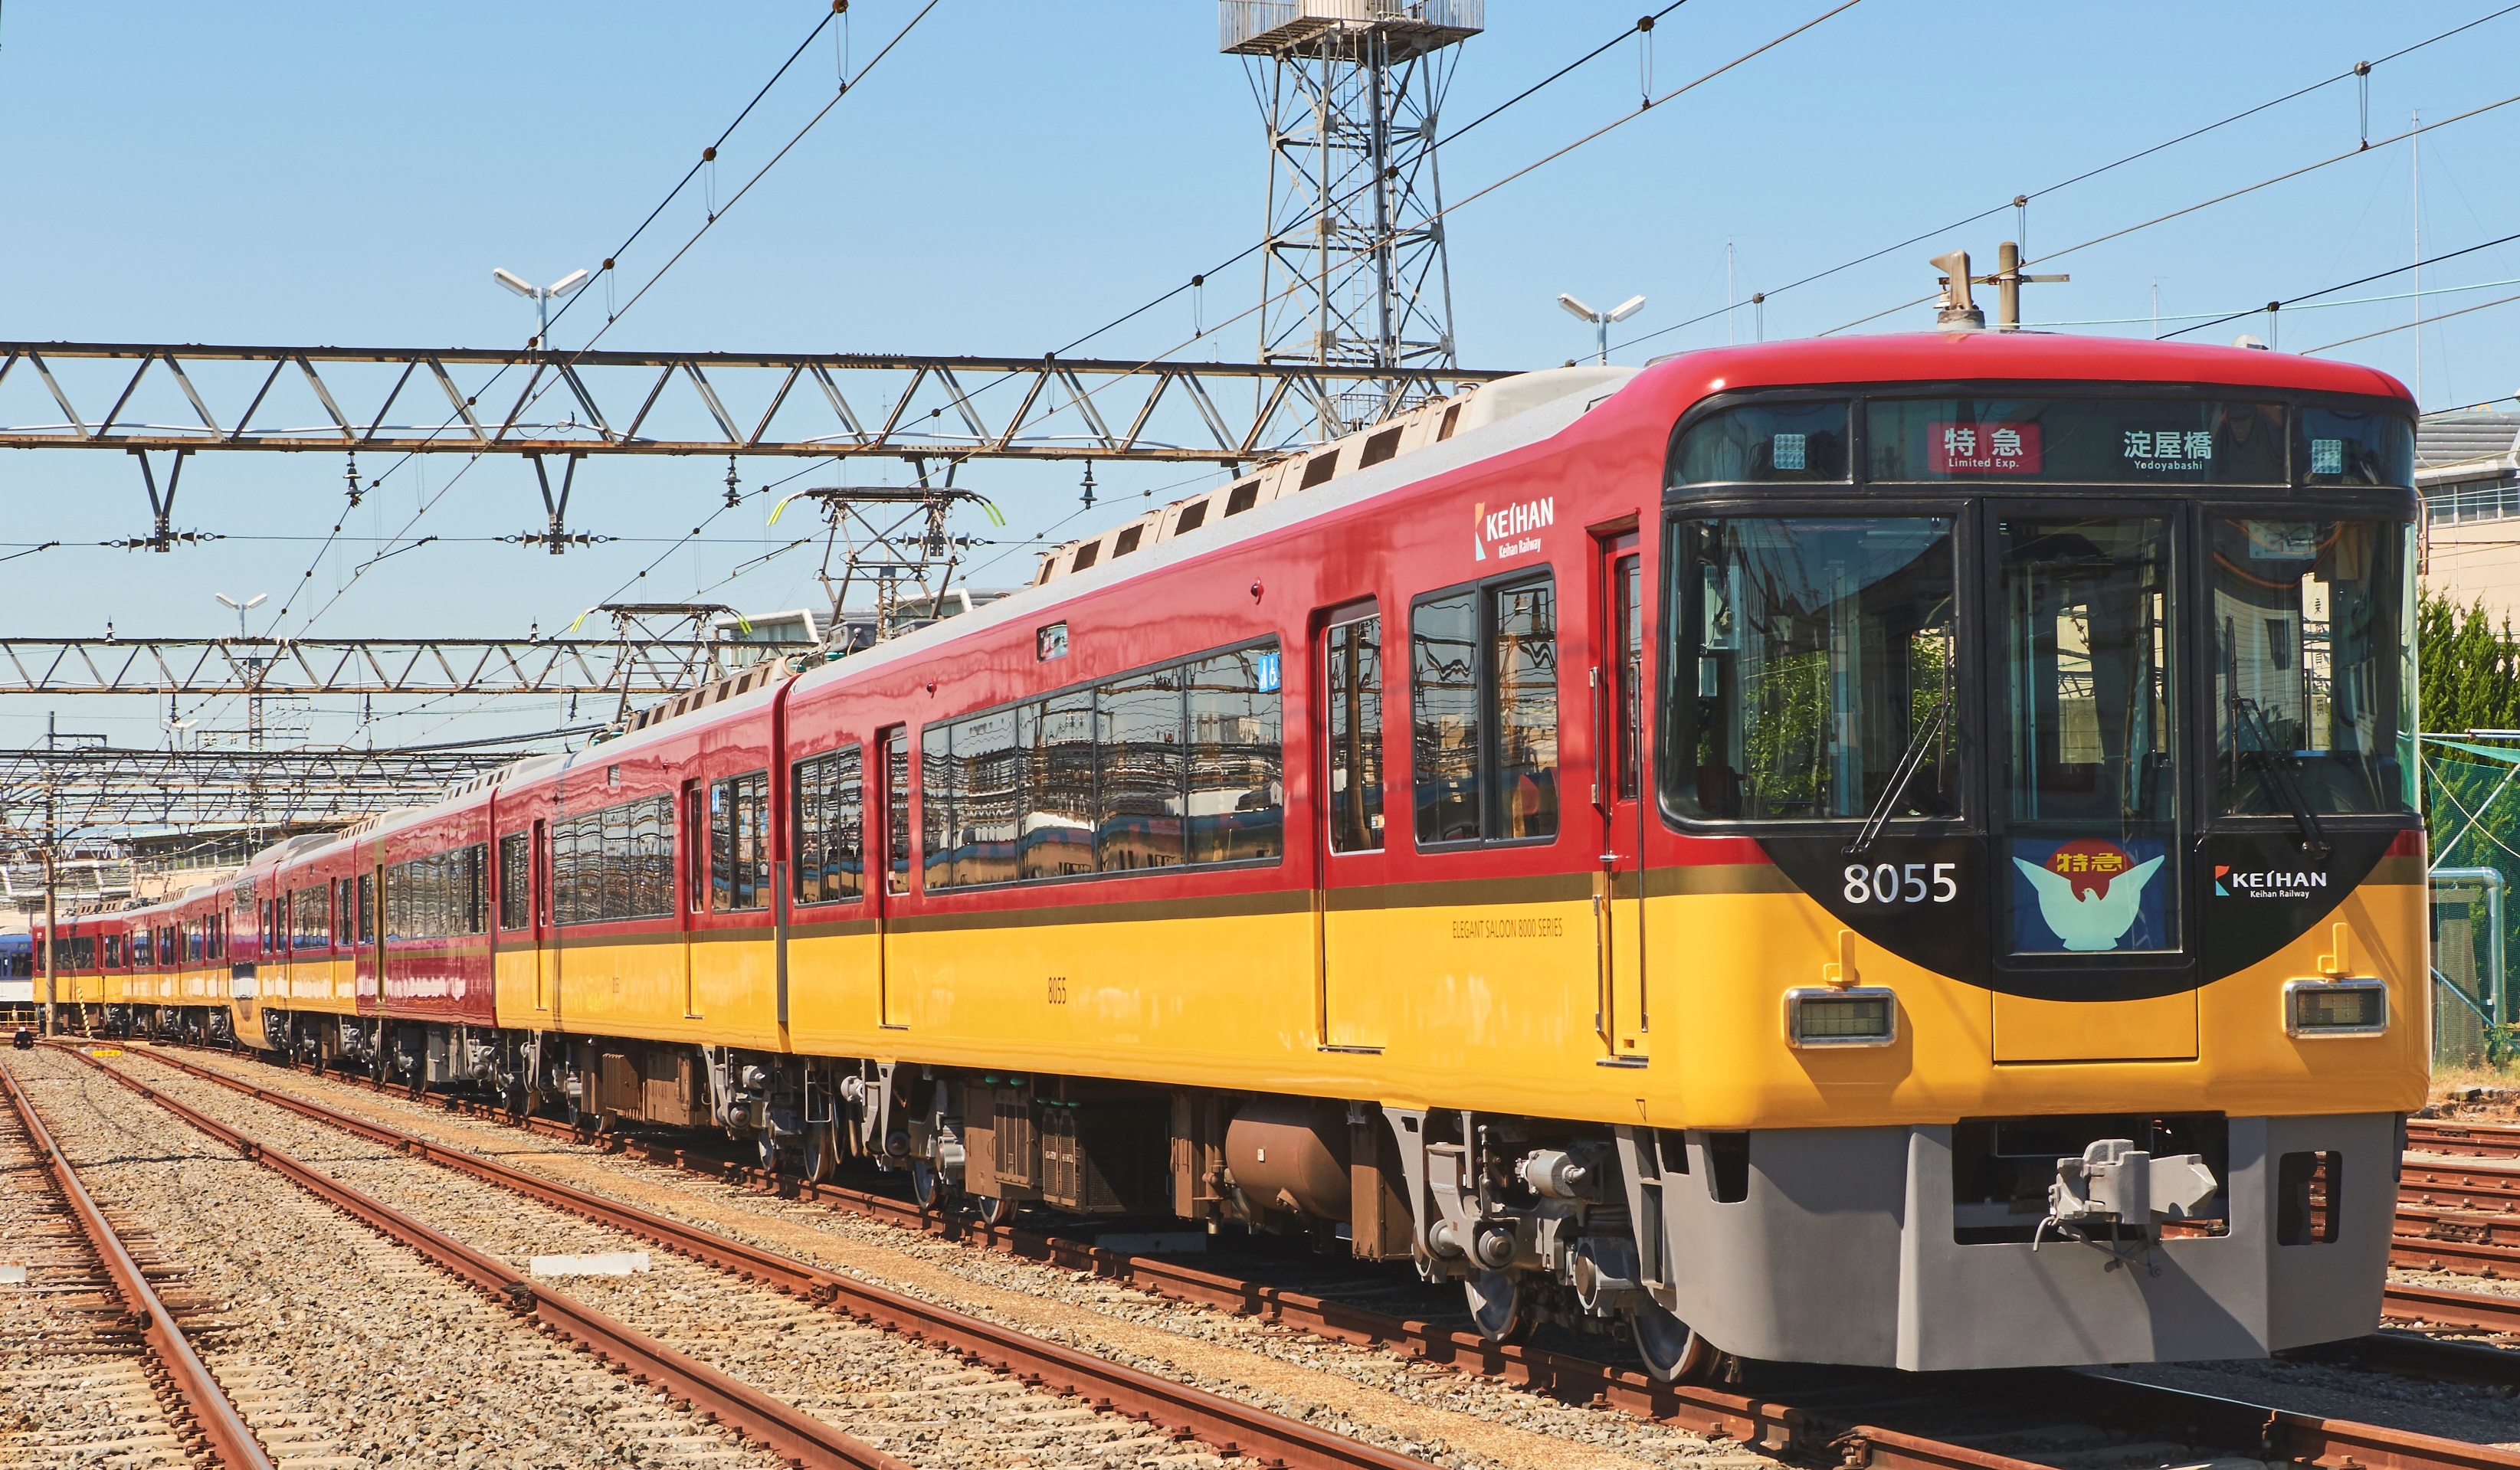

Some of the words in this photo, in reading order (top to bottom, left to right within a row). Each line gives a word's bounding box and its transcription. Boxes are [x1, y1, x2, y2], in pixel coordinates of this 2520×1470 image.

[1944, 427, 2024, 457] 特急
[2123, 431, 2213, 460] 淀屋橋
[1948, 457, 1991, 468] Limited
[1995, 458, 2020, 470] Exp.
[2134, 460, 2204, 472] Yodoyabashi
[1486, 496, 1553, 542] KEIHAN
[1499, 542, 1519, 559] Keihan
[1519, 536, 1542, 553] Railway
[2056, 853, 2122, 873] 特急
[1843, 863, 1958, 904] 8055
[2233, 870, 2327, 888] KEIHAN
[2250, 889, 2277, 898] Keihan
[2279, 889, 2310, 899] Railway
[1453, 920, 1484, 938] ELEGANT
[1485, 919, 1516, 938] SALOON
[1518, 918, 1536, 938] 8000
[1538, 918, 1563, 937] SERIES
[1047, 977, 1067, 1004] 8055
